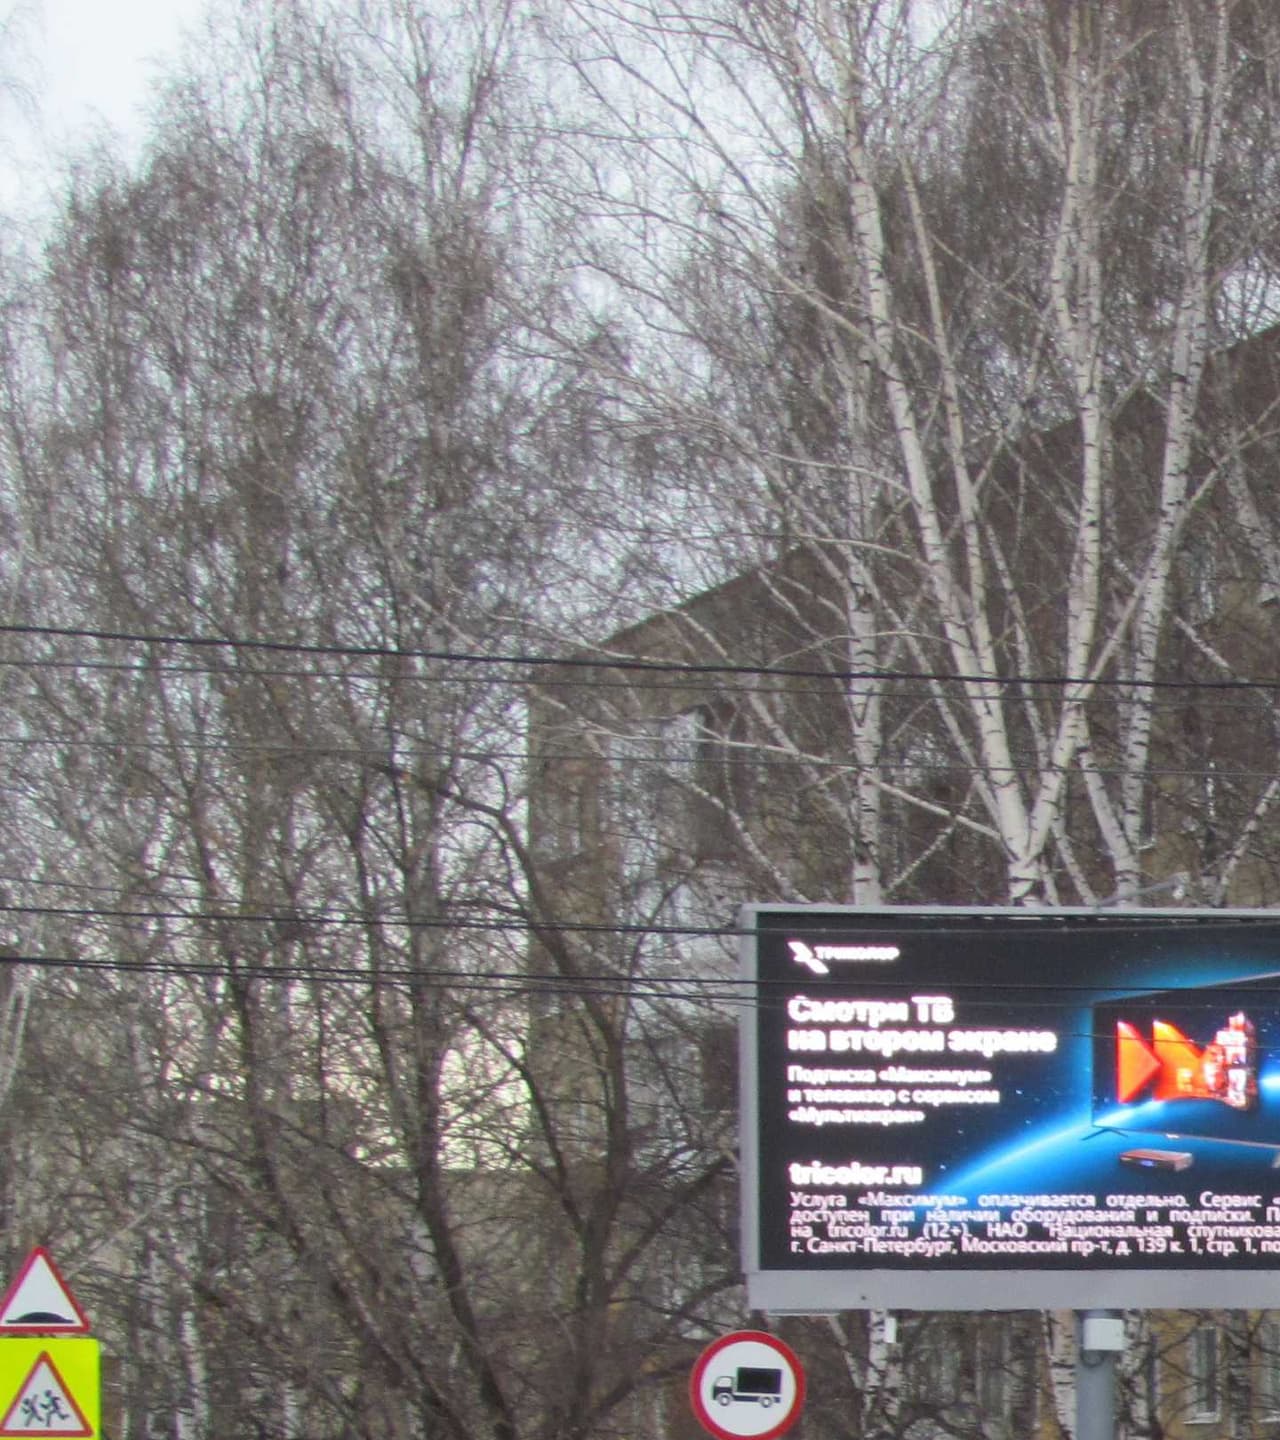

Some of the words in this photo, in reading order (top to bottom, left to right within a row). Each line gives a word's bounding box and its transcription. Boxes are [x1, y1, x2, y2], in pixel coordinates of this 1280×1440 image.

[787, 995, 909, 1028] Смотри
[911, 995, 956, 1024] ТВ
[787, 1030, 827, 1052] на
[829, 1030, 945, 1058] втором
[947, 1030, 1058, 1058] экране
[787, 1065, 877, 1085] Подписка
[803, 1089, 897, 1107] телевизор
[897, 1090, 911, 1103] с
[912, 1089, 1000, 1107] сервисом
[788, 1160, 923, 1185] tricolor.ru
[789, 1191, 848, 1211] Услуга
[857, 1191, 968, 1211] «Максимум»
[977, 1193, 1096, 1208] оплачивается
[1105, 1193, 1190, 1210] отдельно.
[1199, 1191, 1263, 1211] Сервис
[789, 1208, 870, 1226] доступен
[881, 1209, 915, 1226] при
[926, 1209, 1000, 1223] наличии
[1010, 1206, 1136, 1226] оборудования
[1145, 1209, 1159, 1223] и
[1168, 1209, 1256, 1226] подписки.
[790, 1225, 814, 1238] на
[827, 1222, 909, 1238] tricolor.ru
[986, 1223, 1028, 1238] НАО
[1042, 1221, 1174, 1240] "Национальная
[790, 1239, 805, 1254] г.
[806, 1237, 958, 1257] Санкт-Петербург,
[961, 1235, 1068, 1254] Московский
[1136, 1237, 1168, 1253] 139
[1206, 1240, 1239, 1257] стр.
